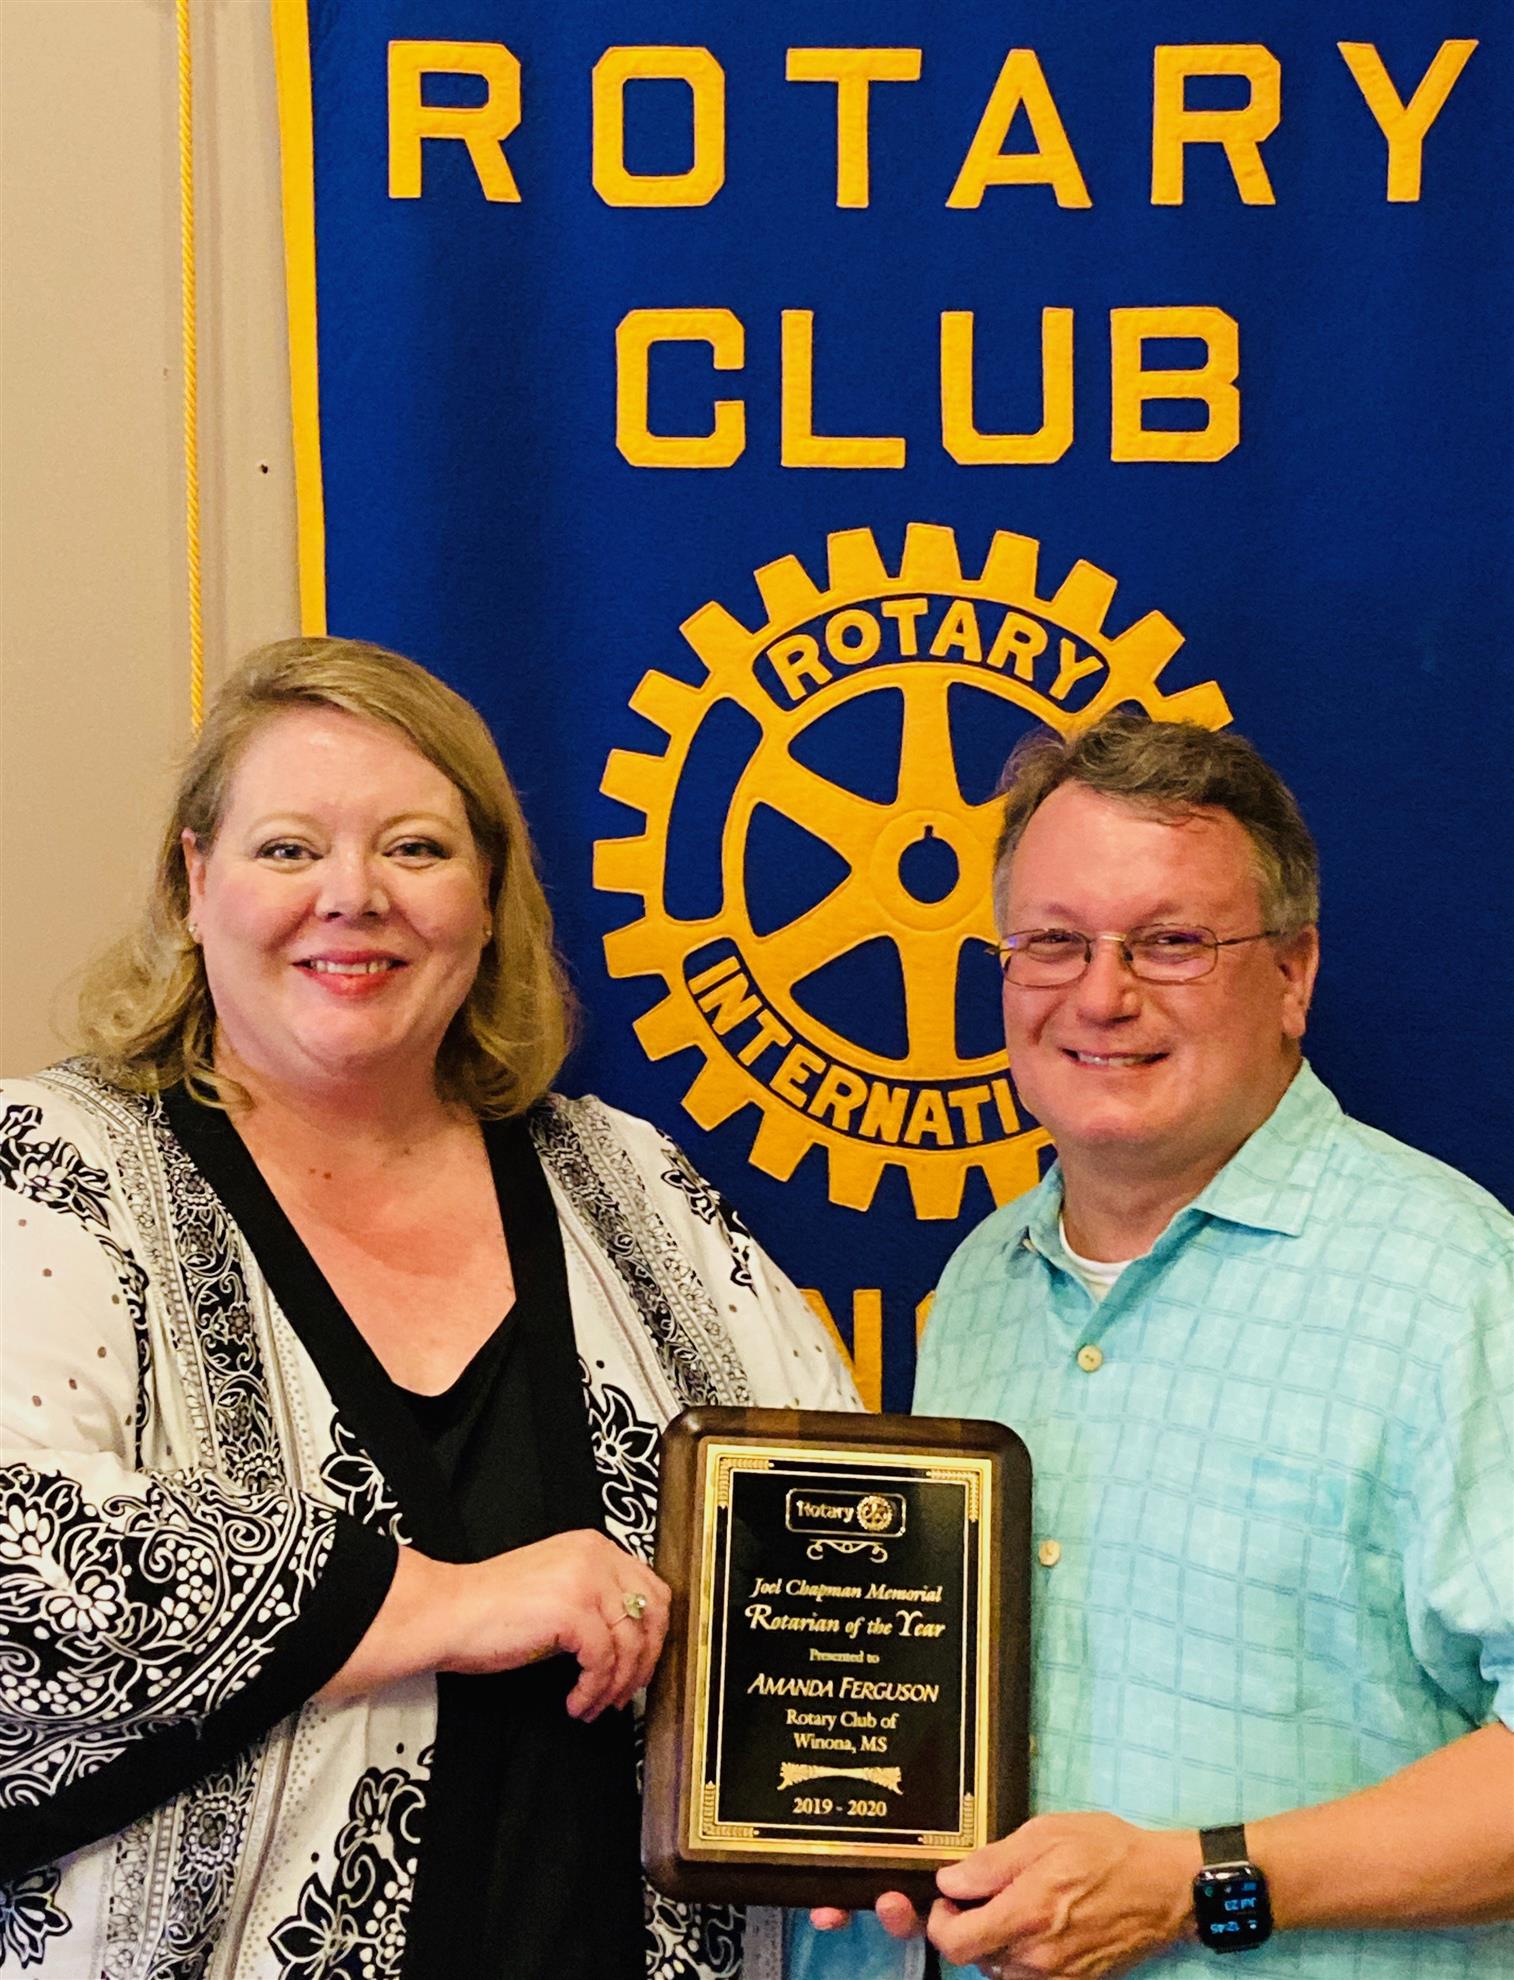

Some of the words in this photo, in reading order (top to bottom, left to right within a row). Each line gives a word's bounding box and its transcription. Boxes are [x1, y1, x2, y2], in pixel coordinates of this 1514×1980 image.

[387, 38, 1480, 209] ROTARY
[615, 305, 1240, 469] CLUB
[766, 597, 1105, 701] ROTARY
[688, 955, 1020, 1146] INTERNATI
[796, 1499, 855, 1524] Rotary
[748, 1577, 783, 1599] Joel
[785, 1579, 862, 1602] Chapman
[864, 1583, 944, 1603] Memorial
[744, 1603, 841, 1633] Rotarian
[844, 1616, 866, 1639] of
[867, 1616, 893, 1636] the
[895, 1609, 947, 1638] Year
[808, 1647, 865, 1664] Presented
[866, 1652, 881, 1664] to
[747, 1672, 835, 1699] AMANDA
[838, 1676, 940, 1703] FERGUSON
[785, 1708, 837, 1731] Rotary
[839, 1711, 878, 1729] Club
[880, 1712, 900, 1729] of
[793, 1732, 858, 1754] Winona,
[860, 1735, 888, 1752] MS
[792, 1797, 834, 1814] 2019
[846, 1800, 888, 1817] 2020
